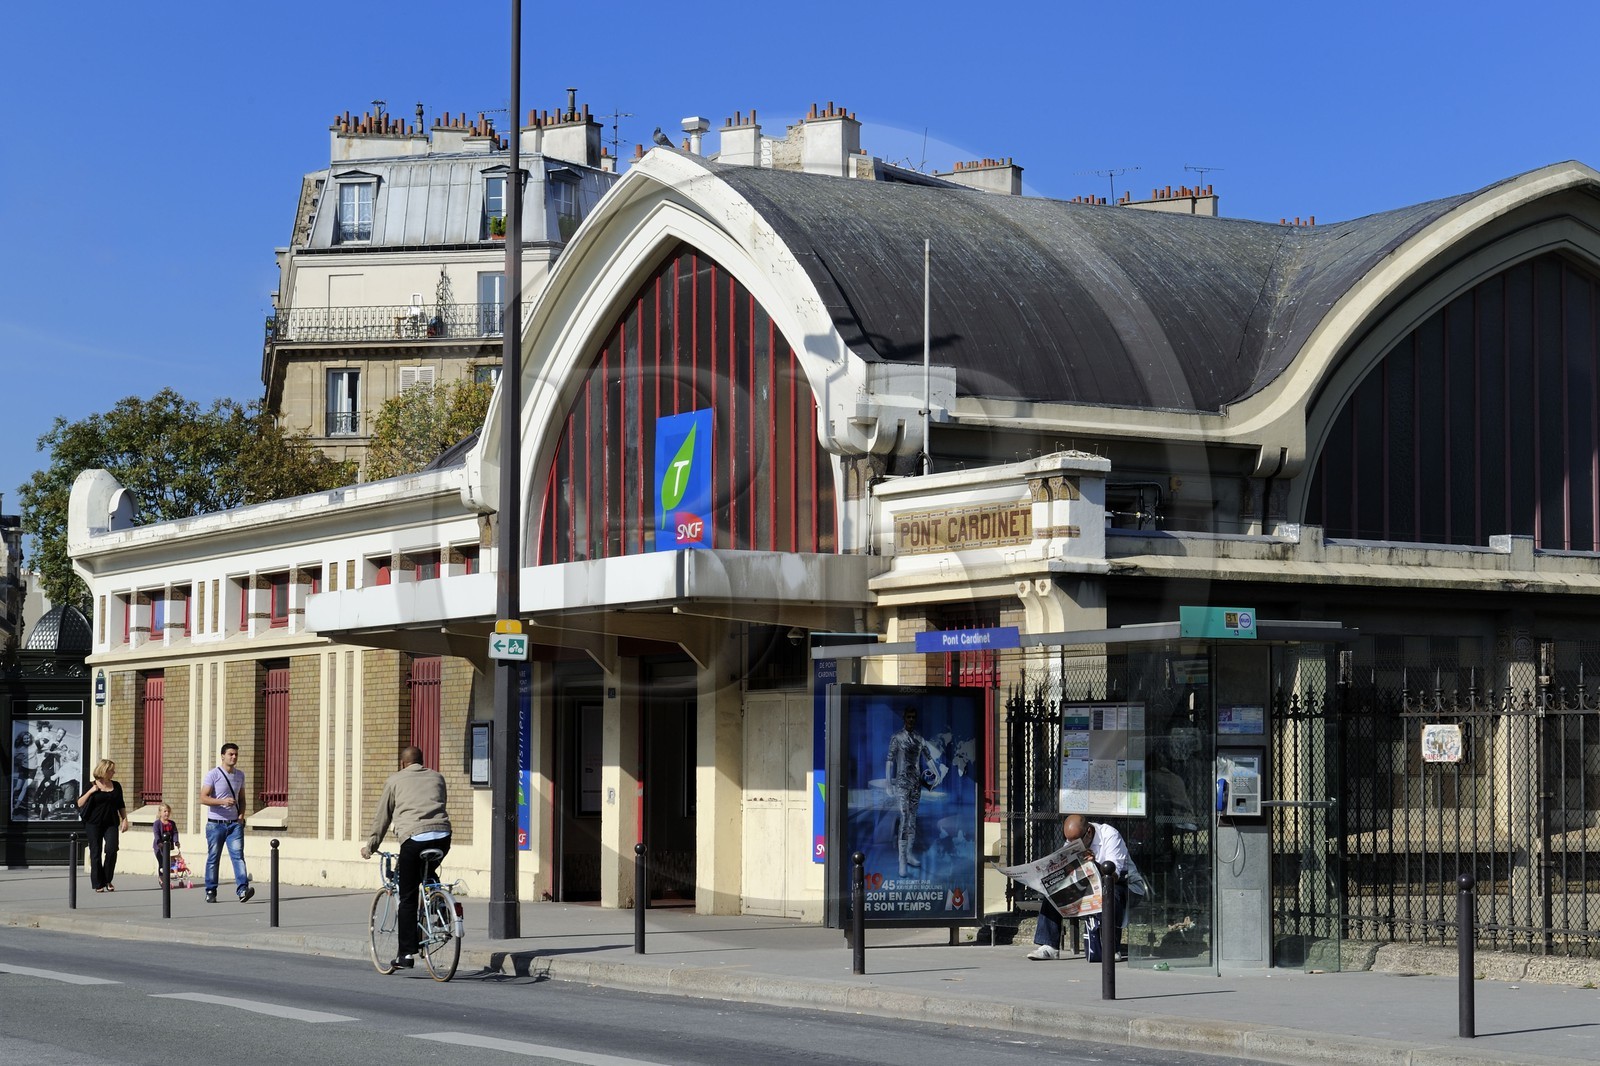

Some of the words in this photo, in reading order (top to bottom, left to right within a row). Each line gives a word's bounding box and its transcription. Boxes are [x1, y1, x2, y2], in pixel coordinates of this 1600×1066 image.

[674, 460, 690, 497] T
[677, 522, 702, 540] SNCF
[901, 520, 941, 547] PONT
[947, 509, 1031, 543] CARDINET
[1227, 614, 1237, 622] 31
[943, 635, 958, 645] Pont
[961, 633, 990, 644] Cardinet
[35, 703, 59, 711] Presse
[867, 892, 886, 901] 20H
[889, 892, 902, 900] EN
[905, 891, 944, 900] AVANCE
[874, 902, 895, 911] SON
[897, 902, 932, 911] TEMPS
